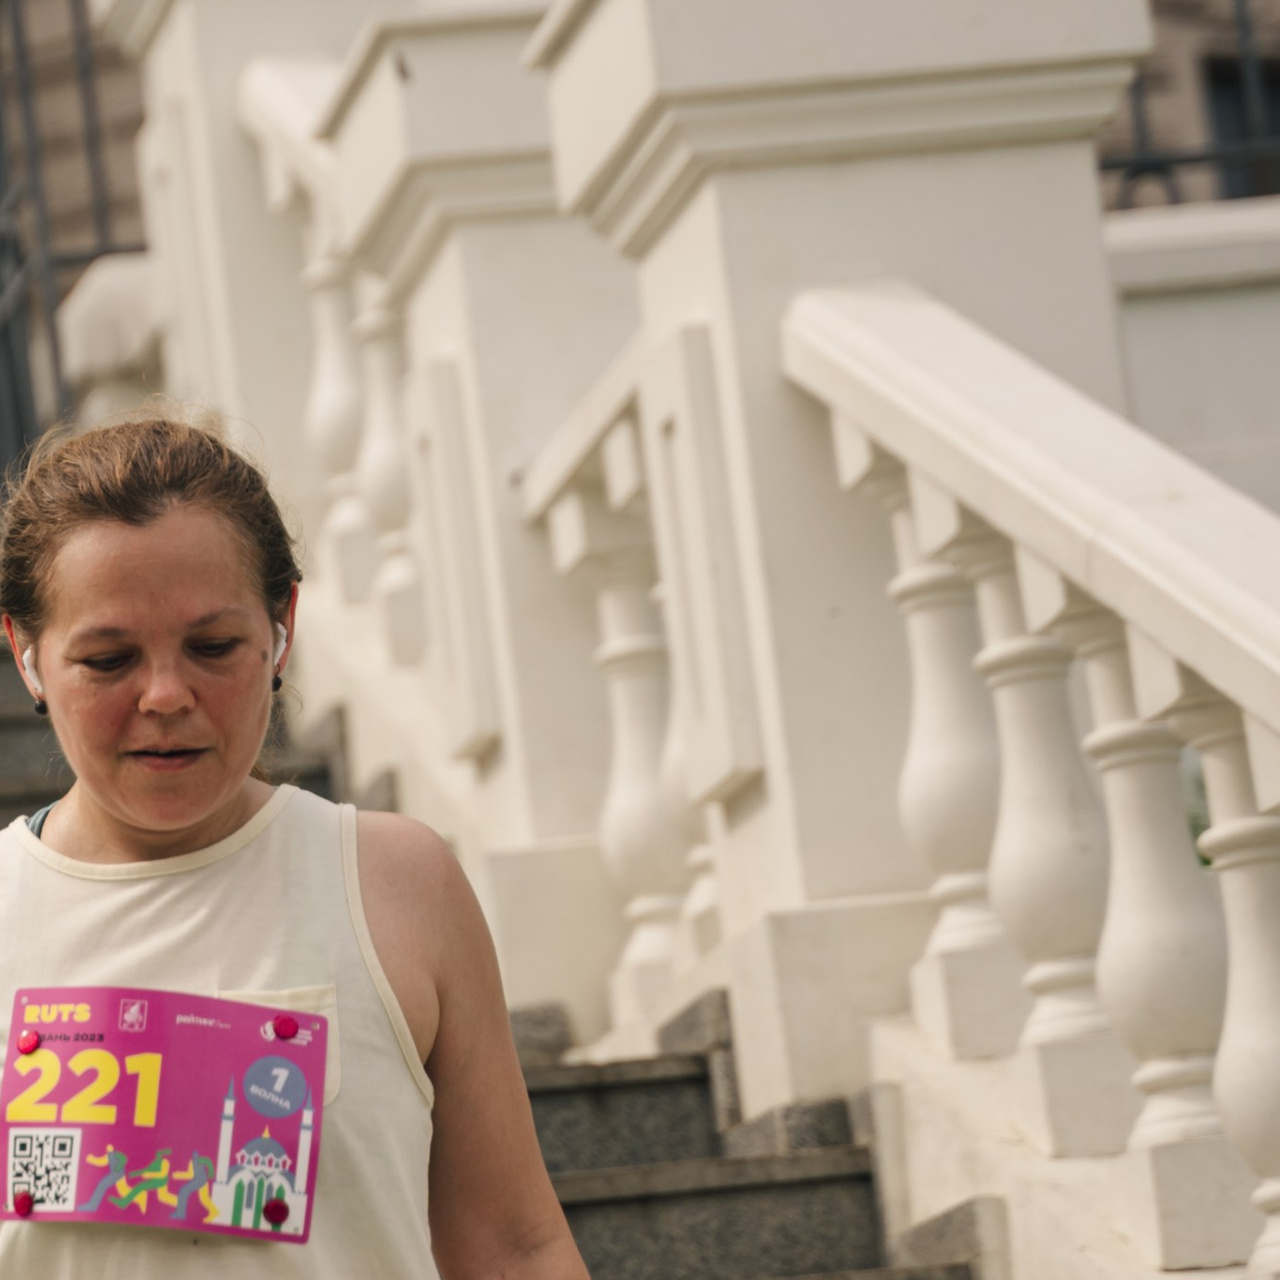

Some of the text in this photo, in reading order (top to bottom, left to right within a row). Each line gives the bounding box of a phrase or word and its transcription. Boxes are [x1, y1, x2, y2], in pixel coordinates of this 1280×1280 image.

[24, 1003, 91, 1024] RUTS
[73, 1031, 104, 1043] 2023
[6, 1048, 163, 1128] 221
[271, 1067, 290, 1094] 1
[249, 1084, 292, 1110] ВОЛНА
